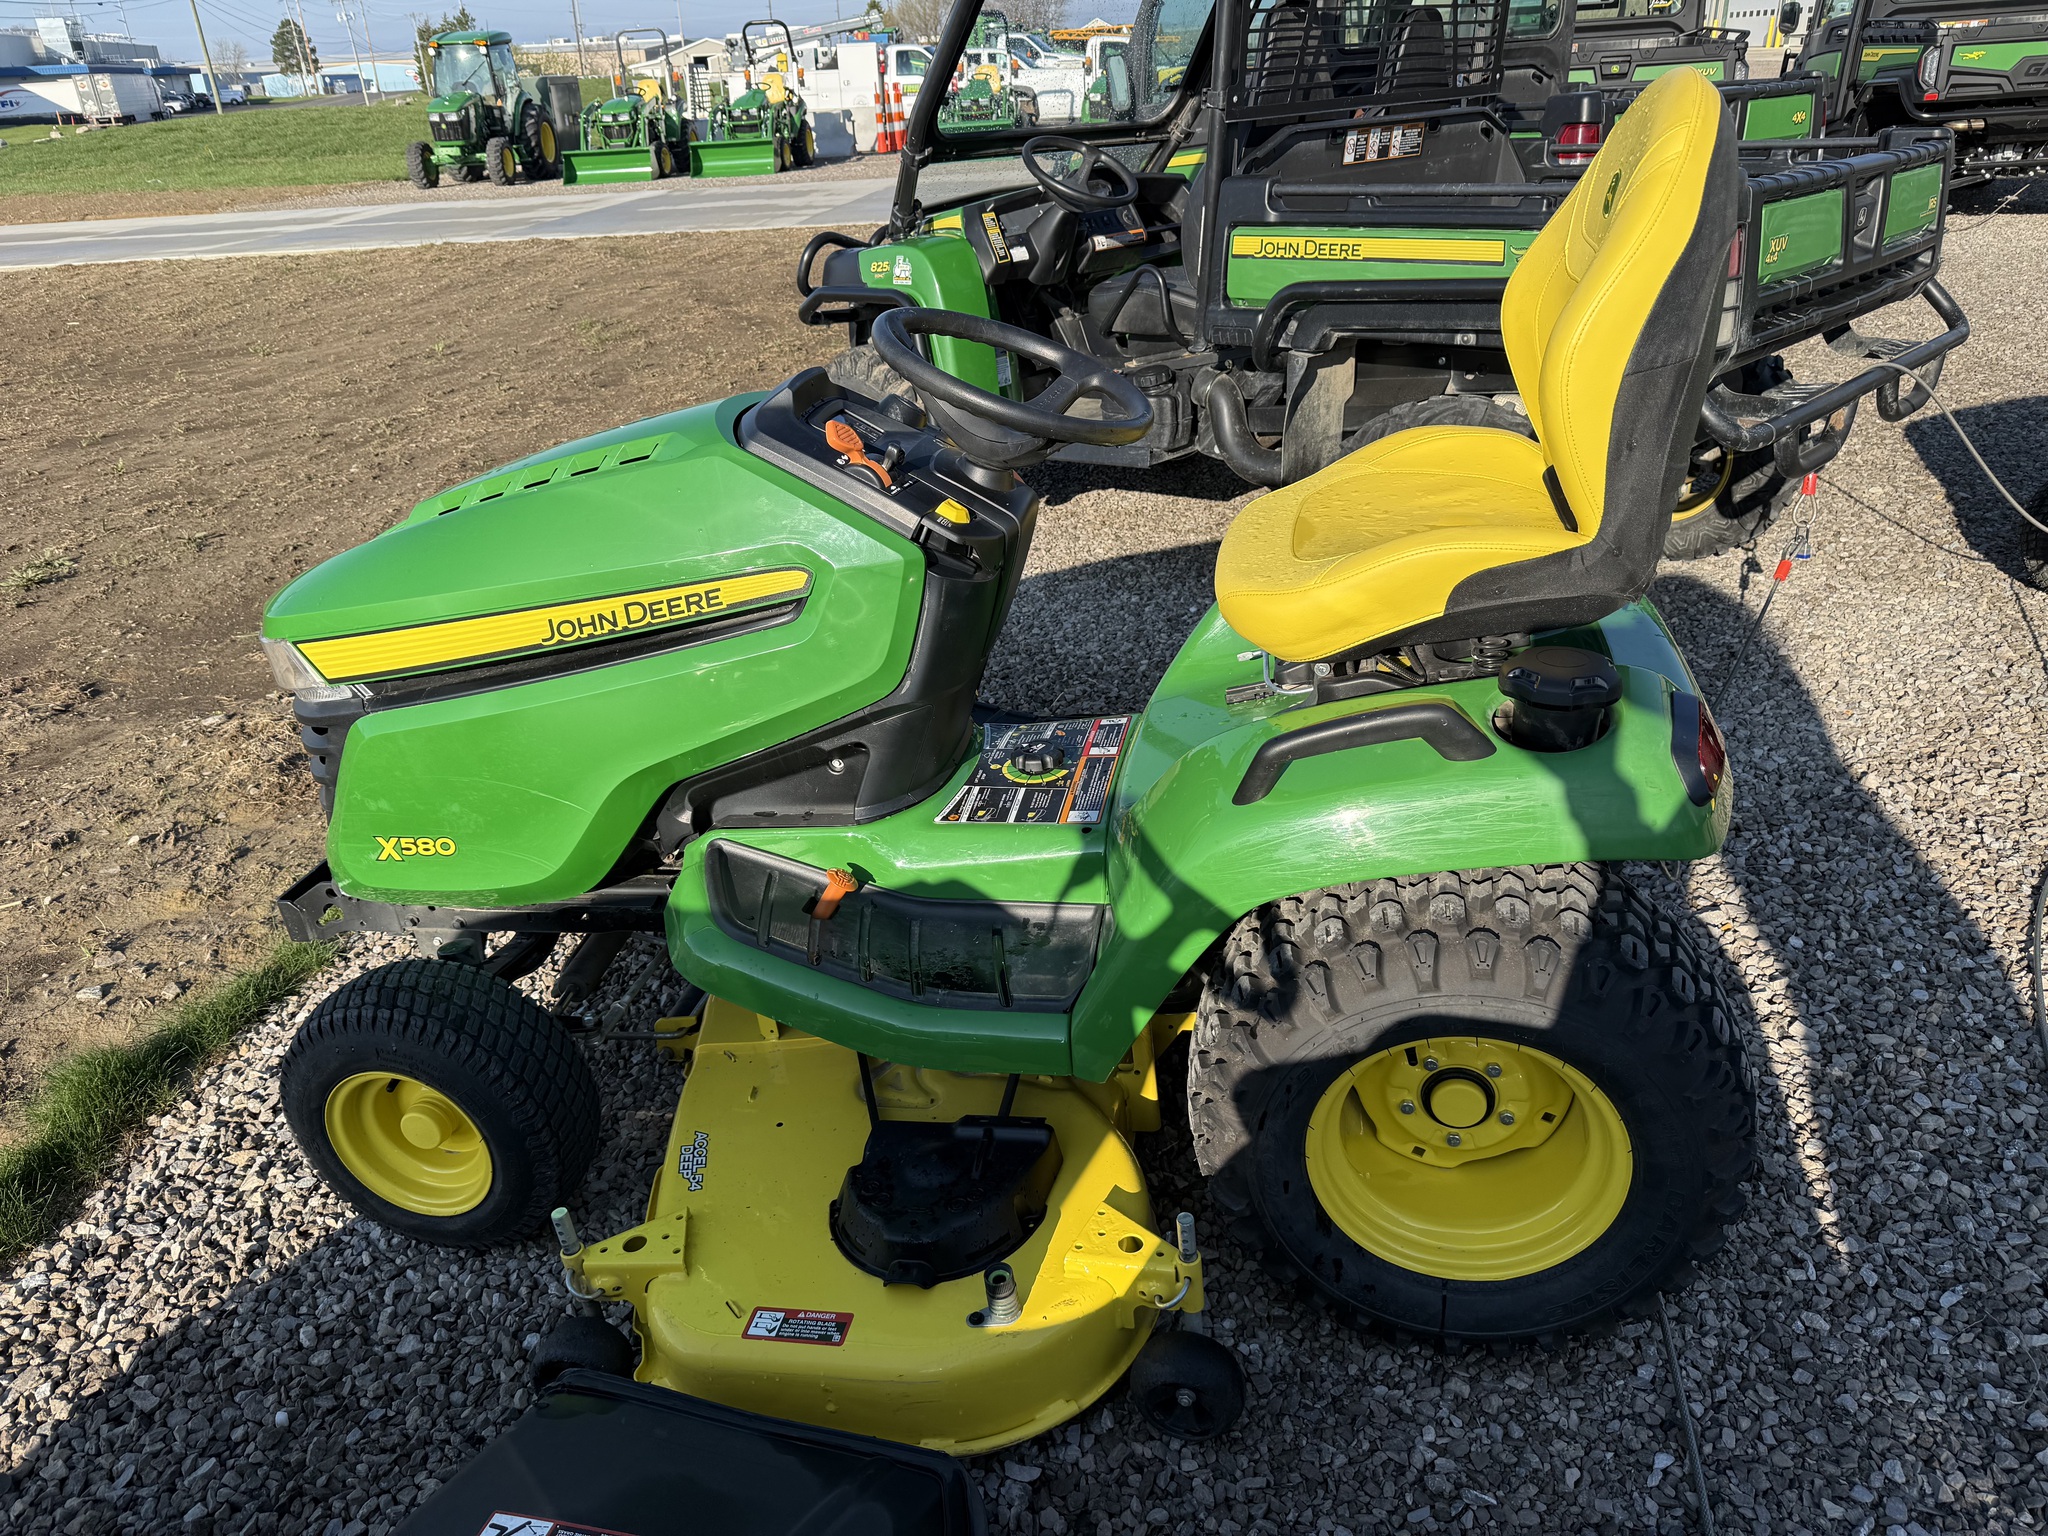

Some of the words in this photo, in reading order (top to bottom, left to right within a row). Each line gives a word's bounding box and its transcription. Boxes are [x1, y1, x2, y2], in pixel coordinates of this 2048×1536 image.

[1254, 239, 1300, 257] JOHN
[1303, 240, 1362, 258] DEERE
[1769, 235, 1789, 253] XUV
[542, 610, 618, 642] JOHN
[624, 587, 723, 626] DEERE
[373, 836, 456, 862] X580
[679, 1145, 693, 1179] DEEP
[692, 1131, 708, 1173] ACCEL
[689, 1174, 703, 1192] 54
[806, 1312, 836, 1320] DANGER
